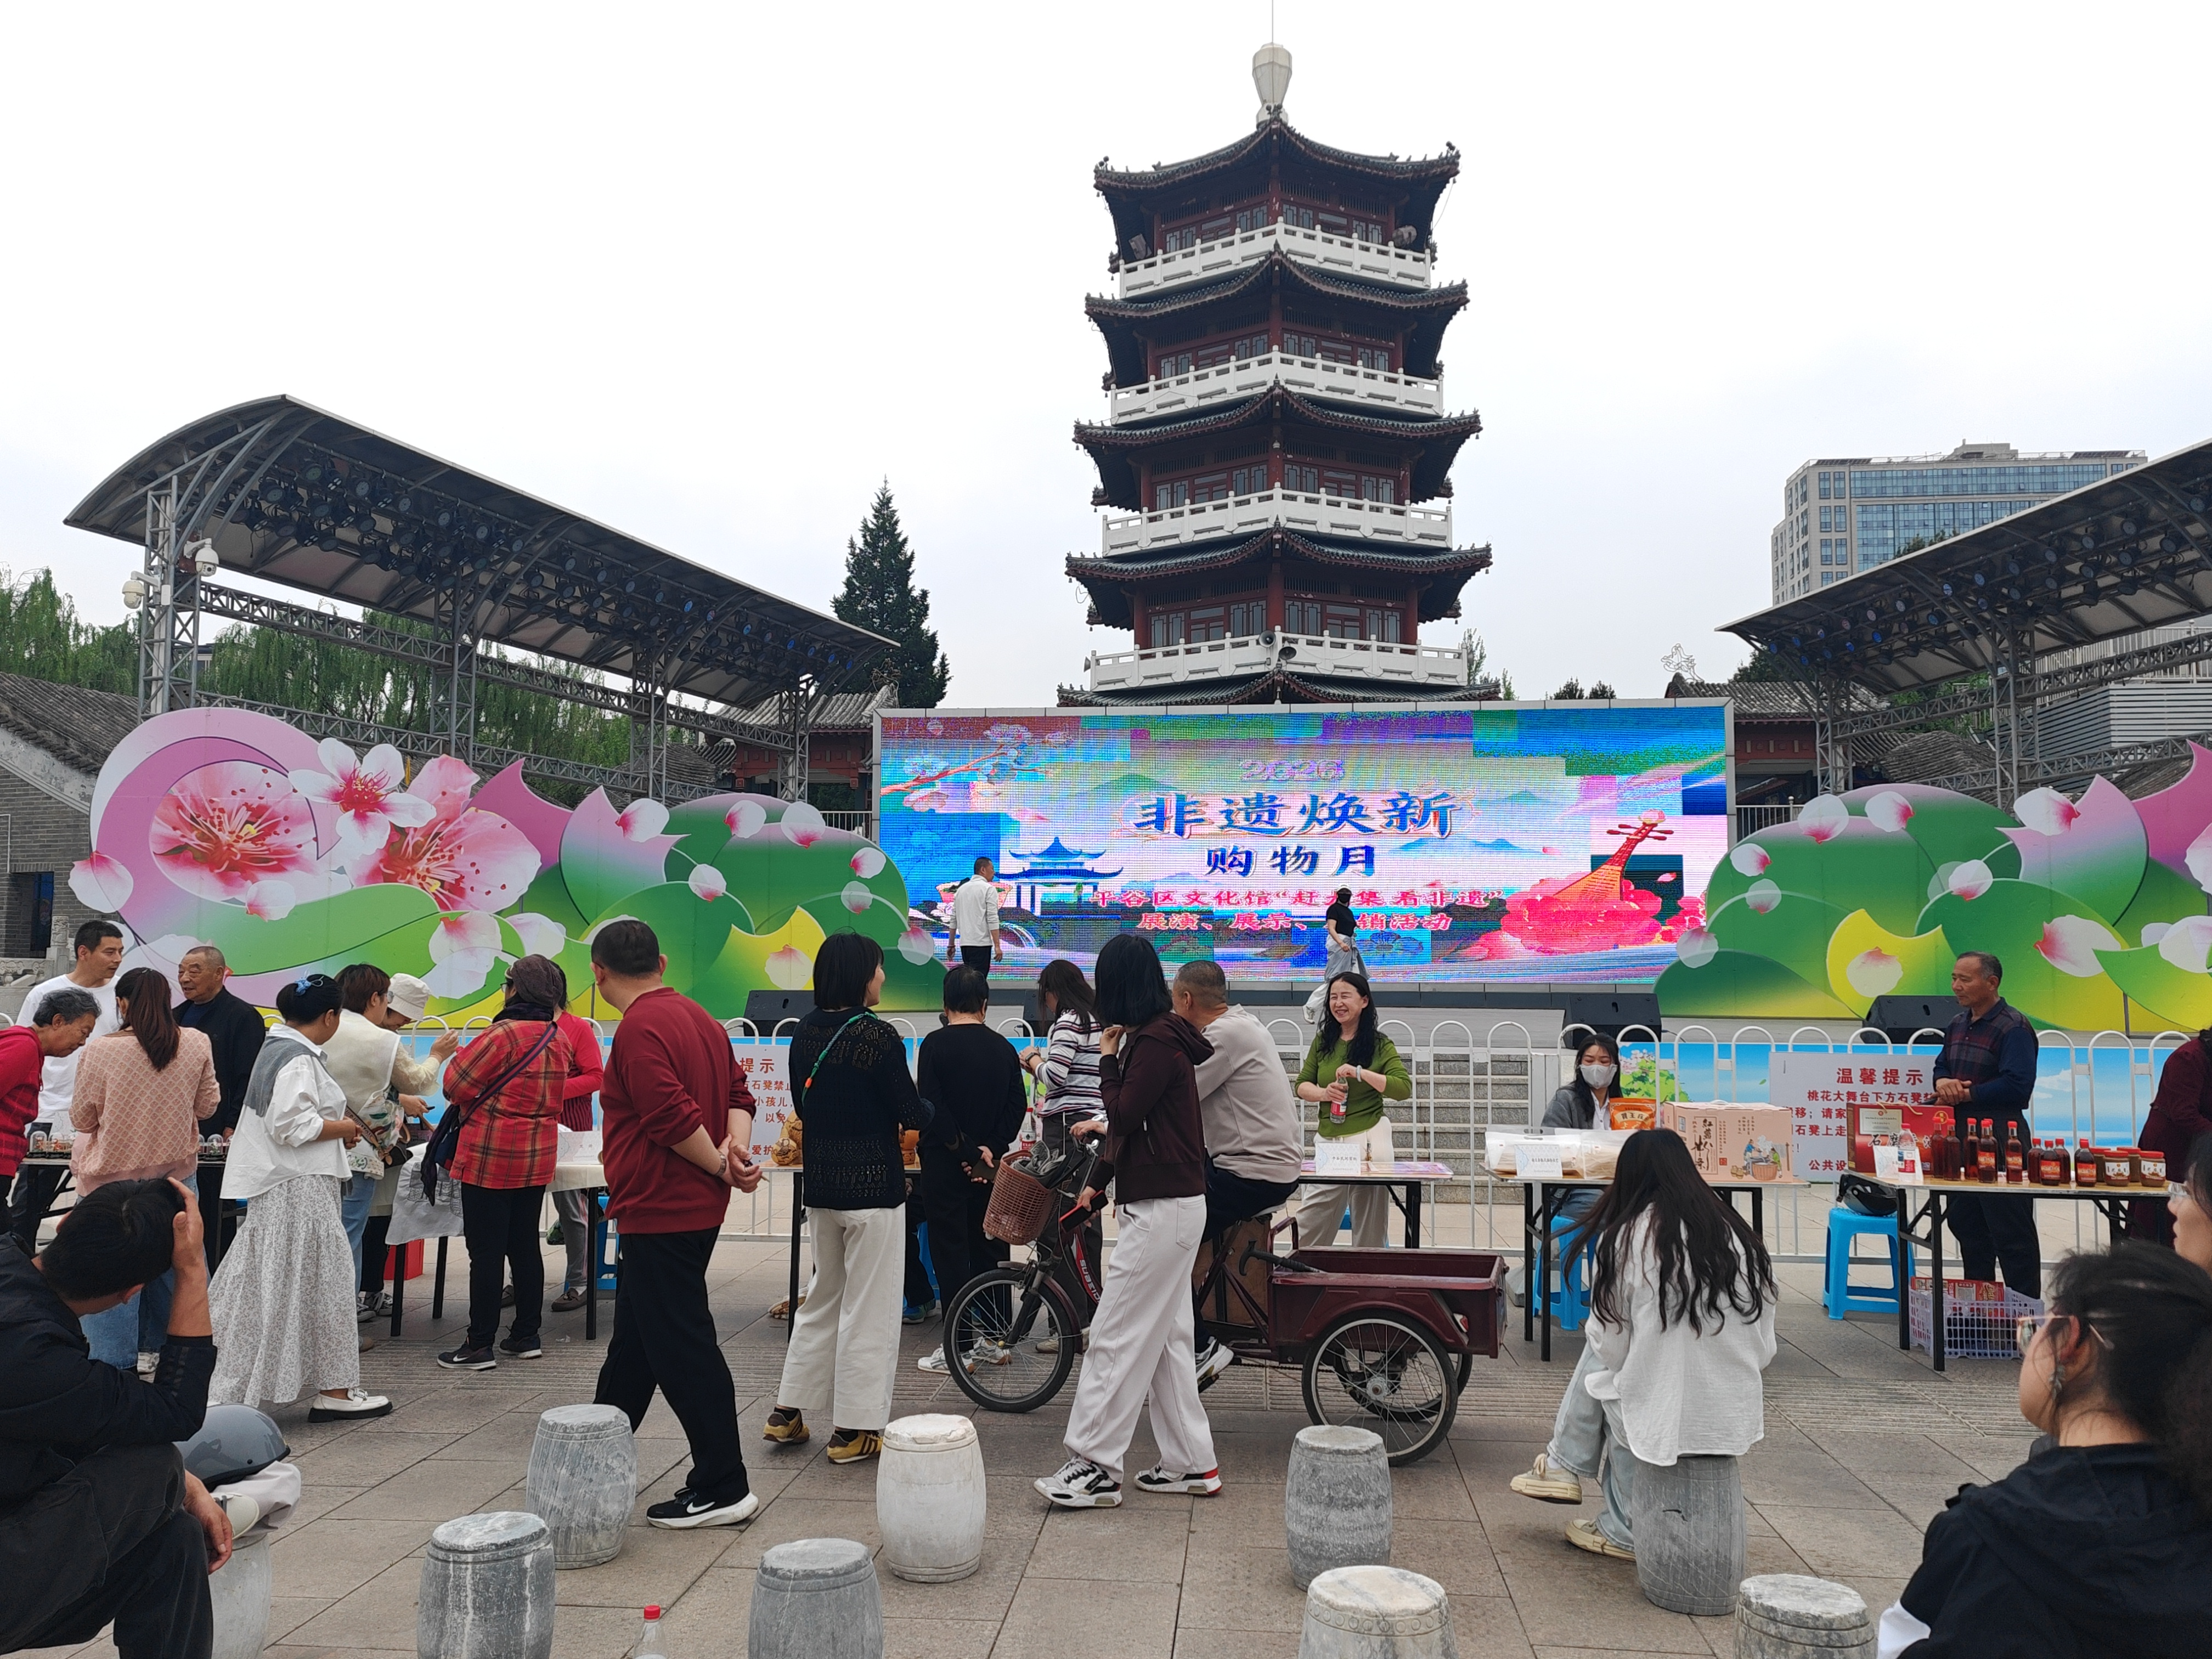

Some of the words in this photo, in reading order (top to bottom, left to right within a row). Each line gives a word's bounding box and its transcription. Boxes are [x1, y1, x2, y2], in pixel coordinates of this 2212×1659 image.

[1134, 790, 1465, 840] 非遗焕新
[1205, 845, 1376, 877] 购物月
[1136, 912, 1453, 931] 展演、展示、销活动
[740, 1057, 774, 1074] 提示
[1836, 1067, 1923, 1086] 温馨提示
[1786, 1106, 1847, 1119] 移；请家
[1791, 1124, 1847, 1136] 石凳上走
[752, 1144, 774, 1155] 爱护
[1808, 1159, 1847, 1171] 公共设
[1080, 1259, 1101, 1304] SUBEID
